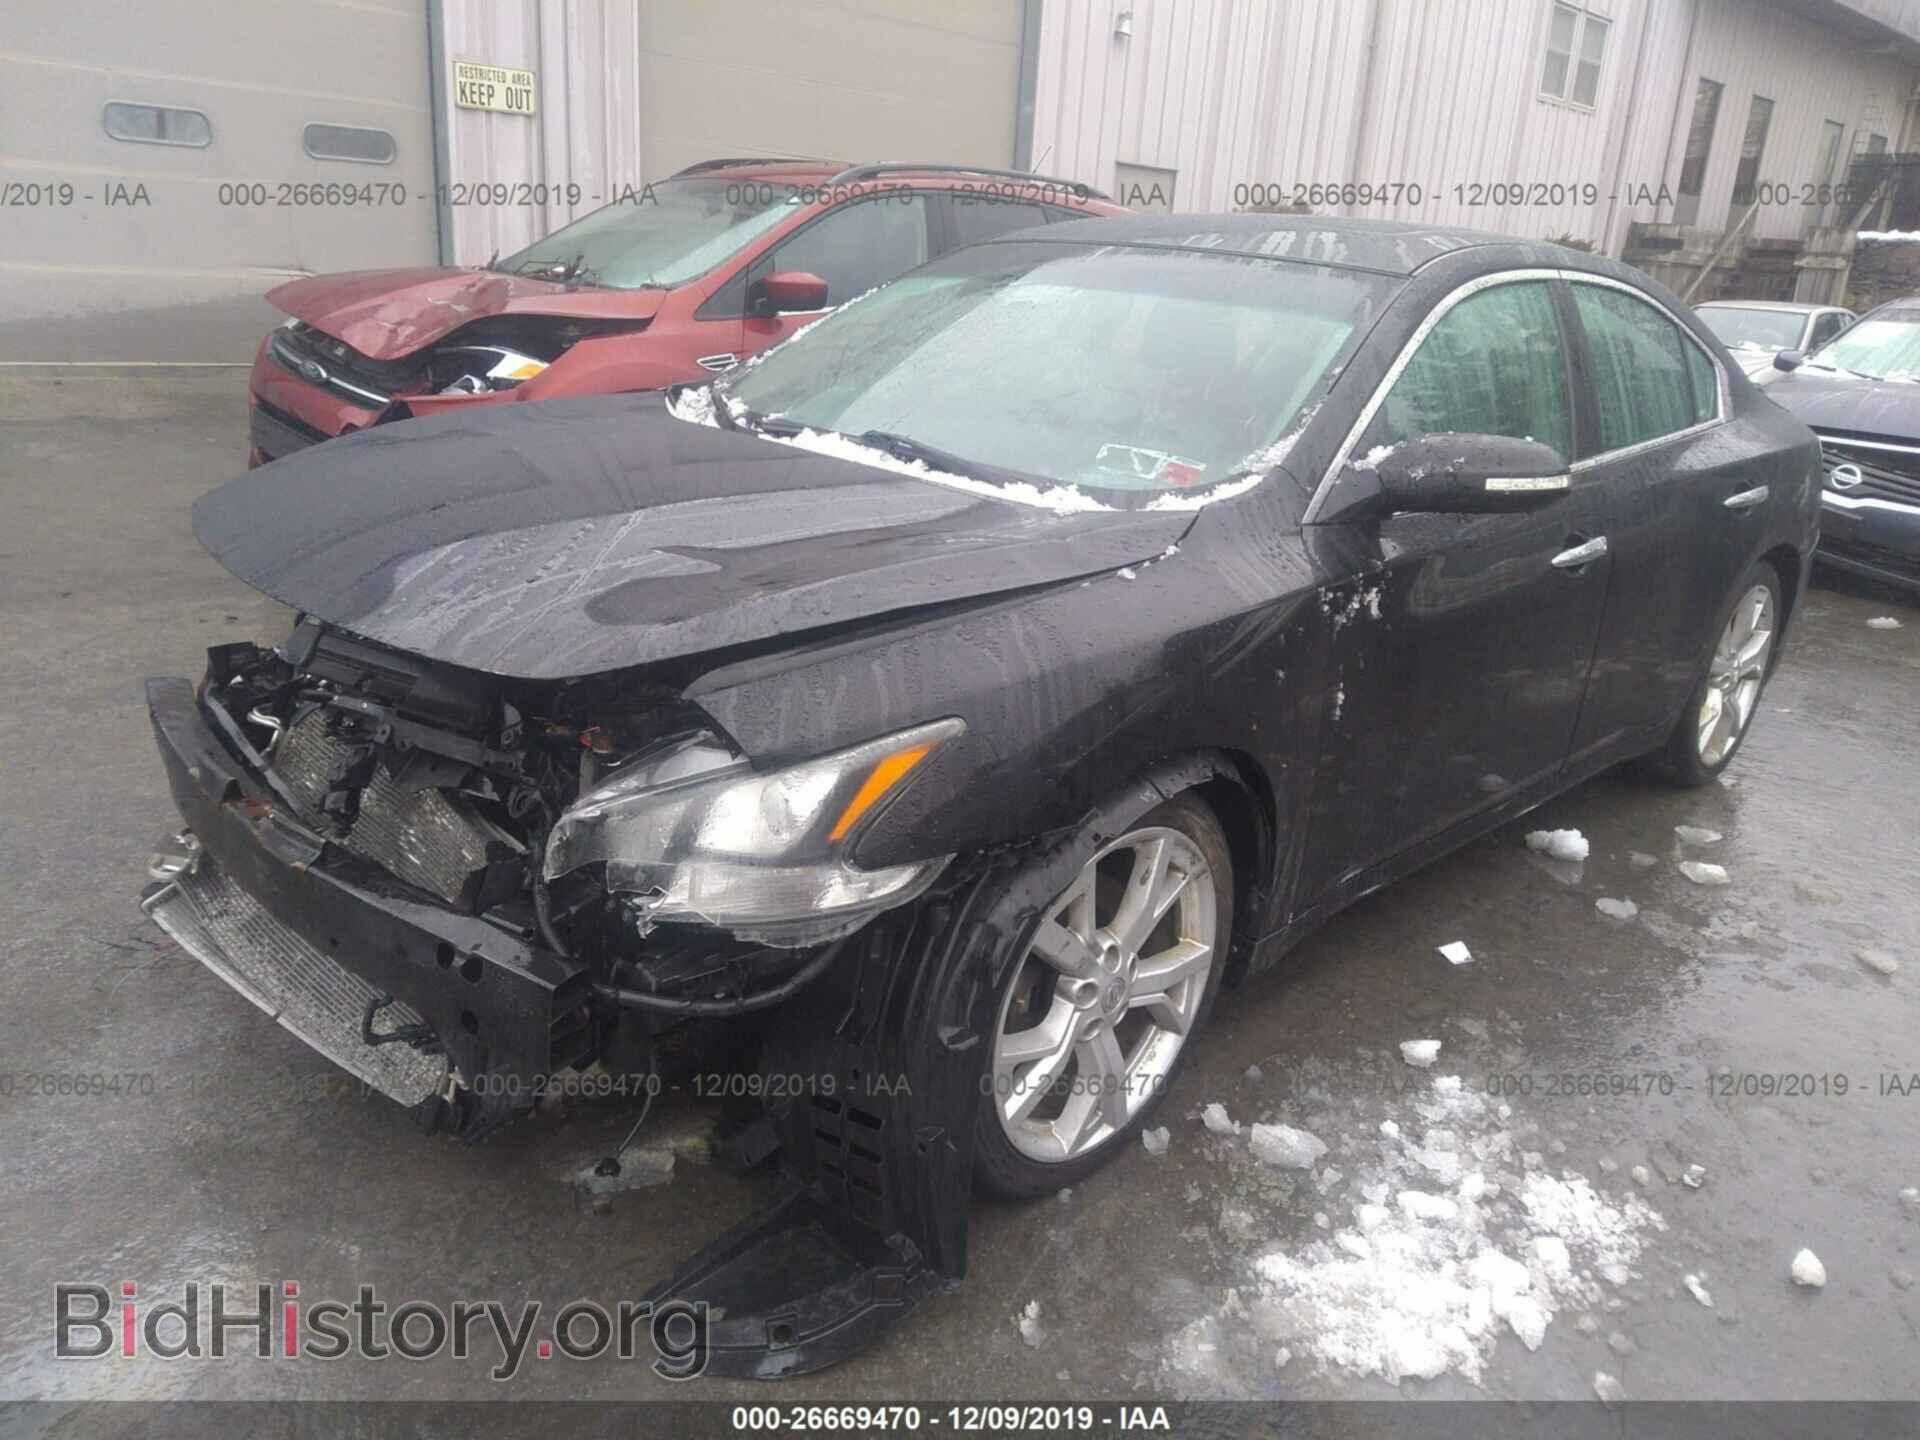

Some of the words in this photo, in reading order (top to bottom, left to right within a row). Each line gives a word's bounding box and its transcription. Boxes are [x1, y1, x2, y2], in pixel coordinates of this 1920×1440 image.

[458, 65, 506, 84] RESTRICTED
[512, 72, 531, 87] AREA
[459, 80, 495, 106] KEEP
[505, 86, 531, 111] OUT
